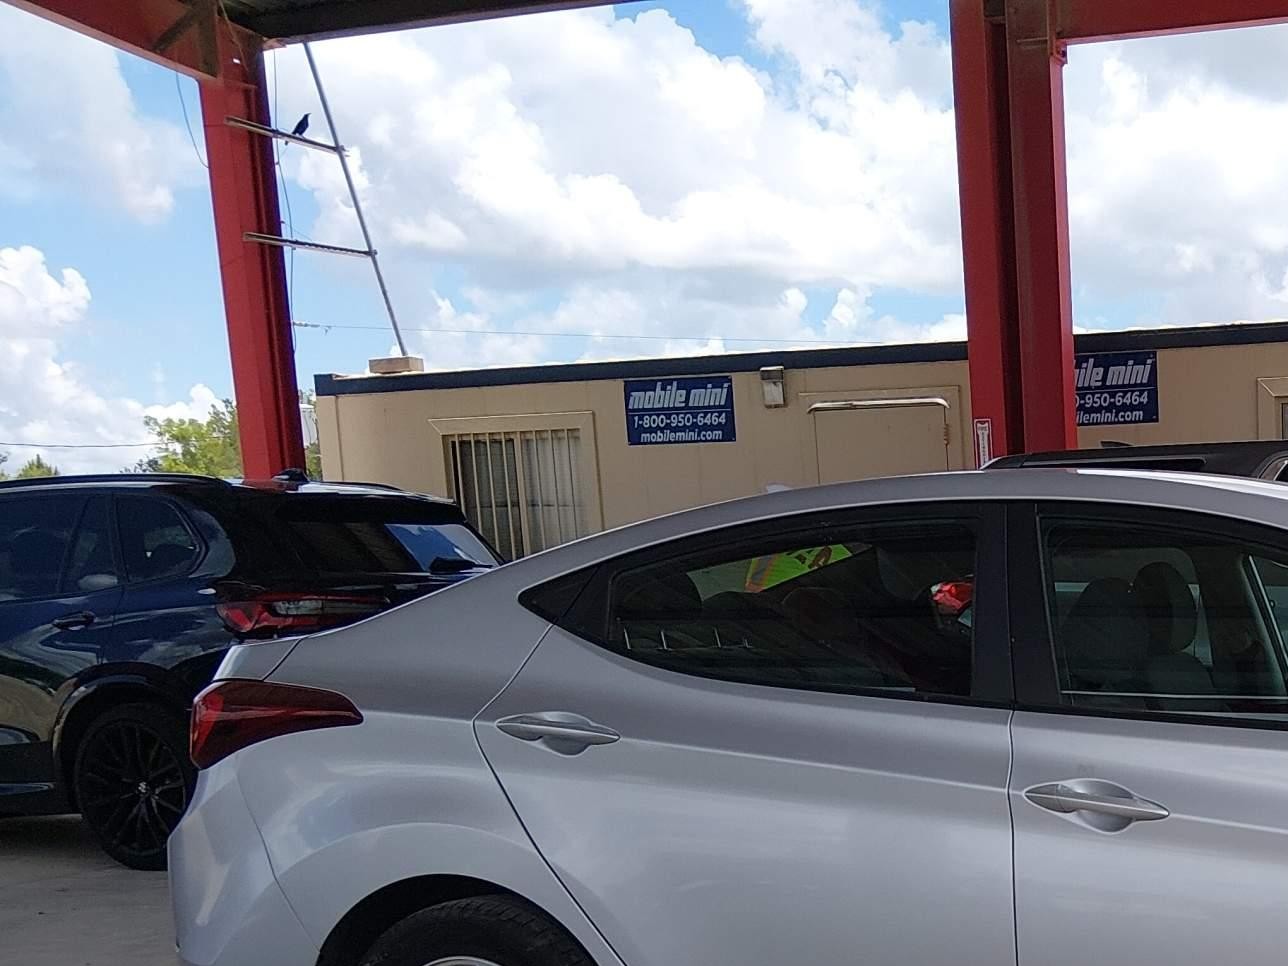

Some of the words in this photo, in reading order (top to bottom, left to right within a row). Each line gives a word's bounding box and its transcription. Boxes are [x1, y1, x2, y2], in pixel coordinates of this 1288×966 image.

[1106, 358, 1153, 386] mini
[628, 380, 687, 410] mobile
[688, 383, 729, 407] mini
[634, 412, 726, 428] 1-800-950-6464
[1076, 409, 1143, 424] ilemini.com
[640, 428, 723, 443] mobilemini.com
